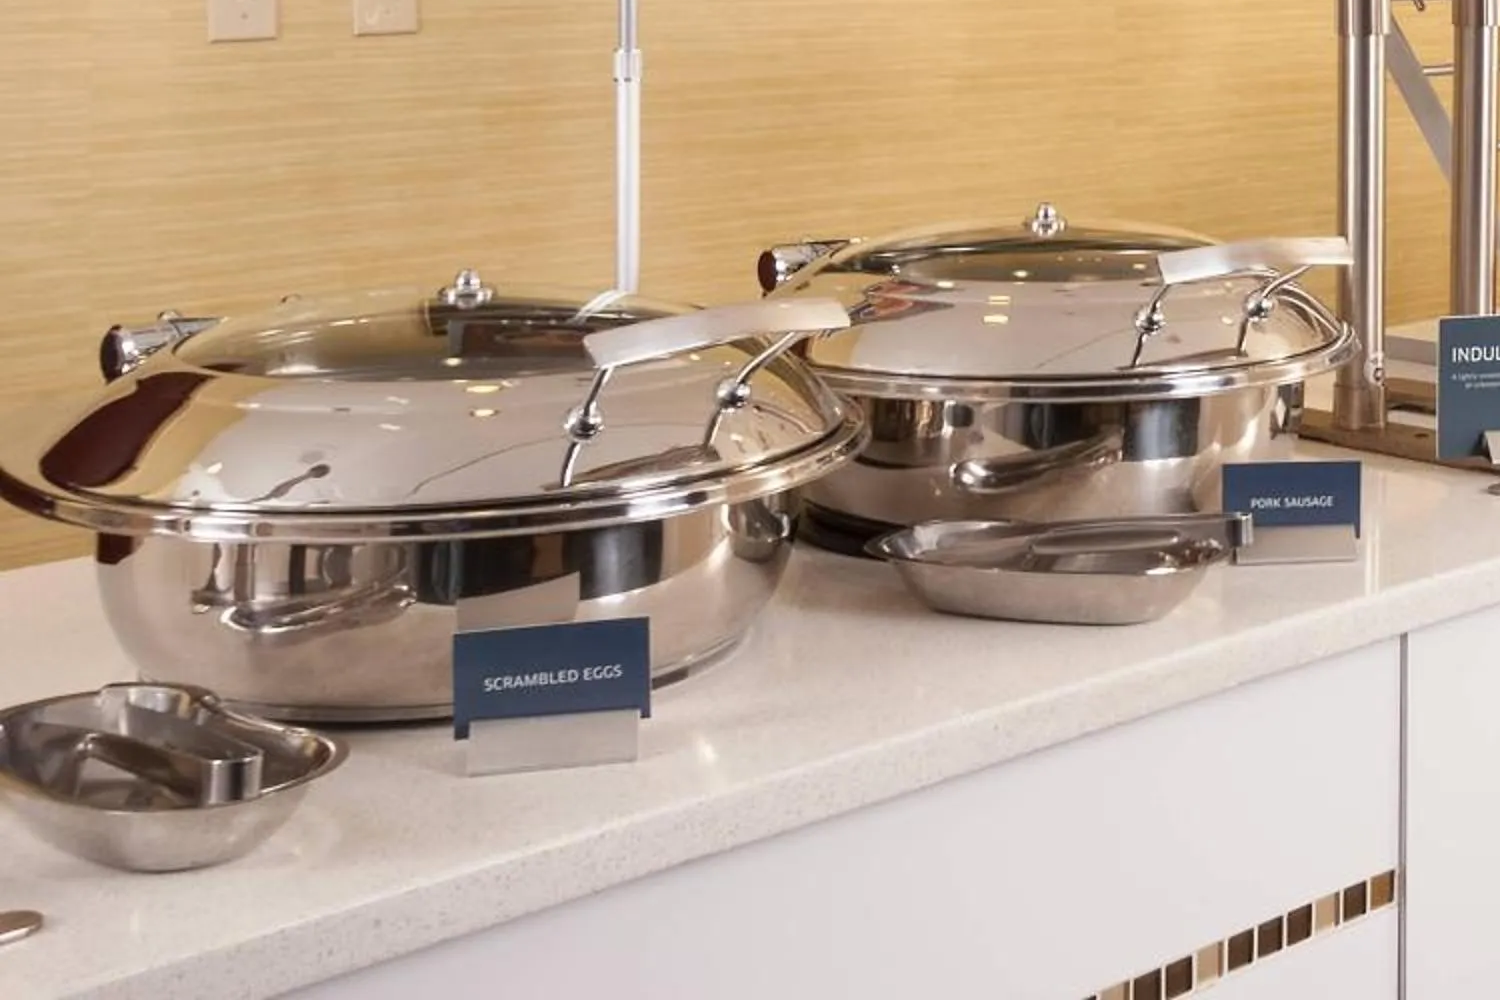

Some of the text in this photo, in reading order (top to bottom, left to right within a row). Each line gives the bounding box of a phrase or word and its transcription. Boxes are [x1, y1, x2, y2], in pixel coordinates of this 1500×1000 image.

[1250, 495, 1334, 509] PORK SAUSAGE
[484, 664, 623, 692] SCRAMBLED EGGS
